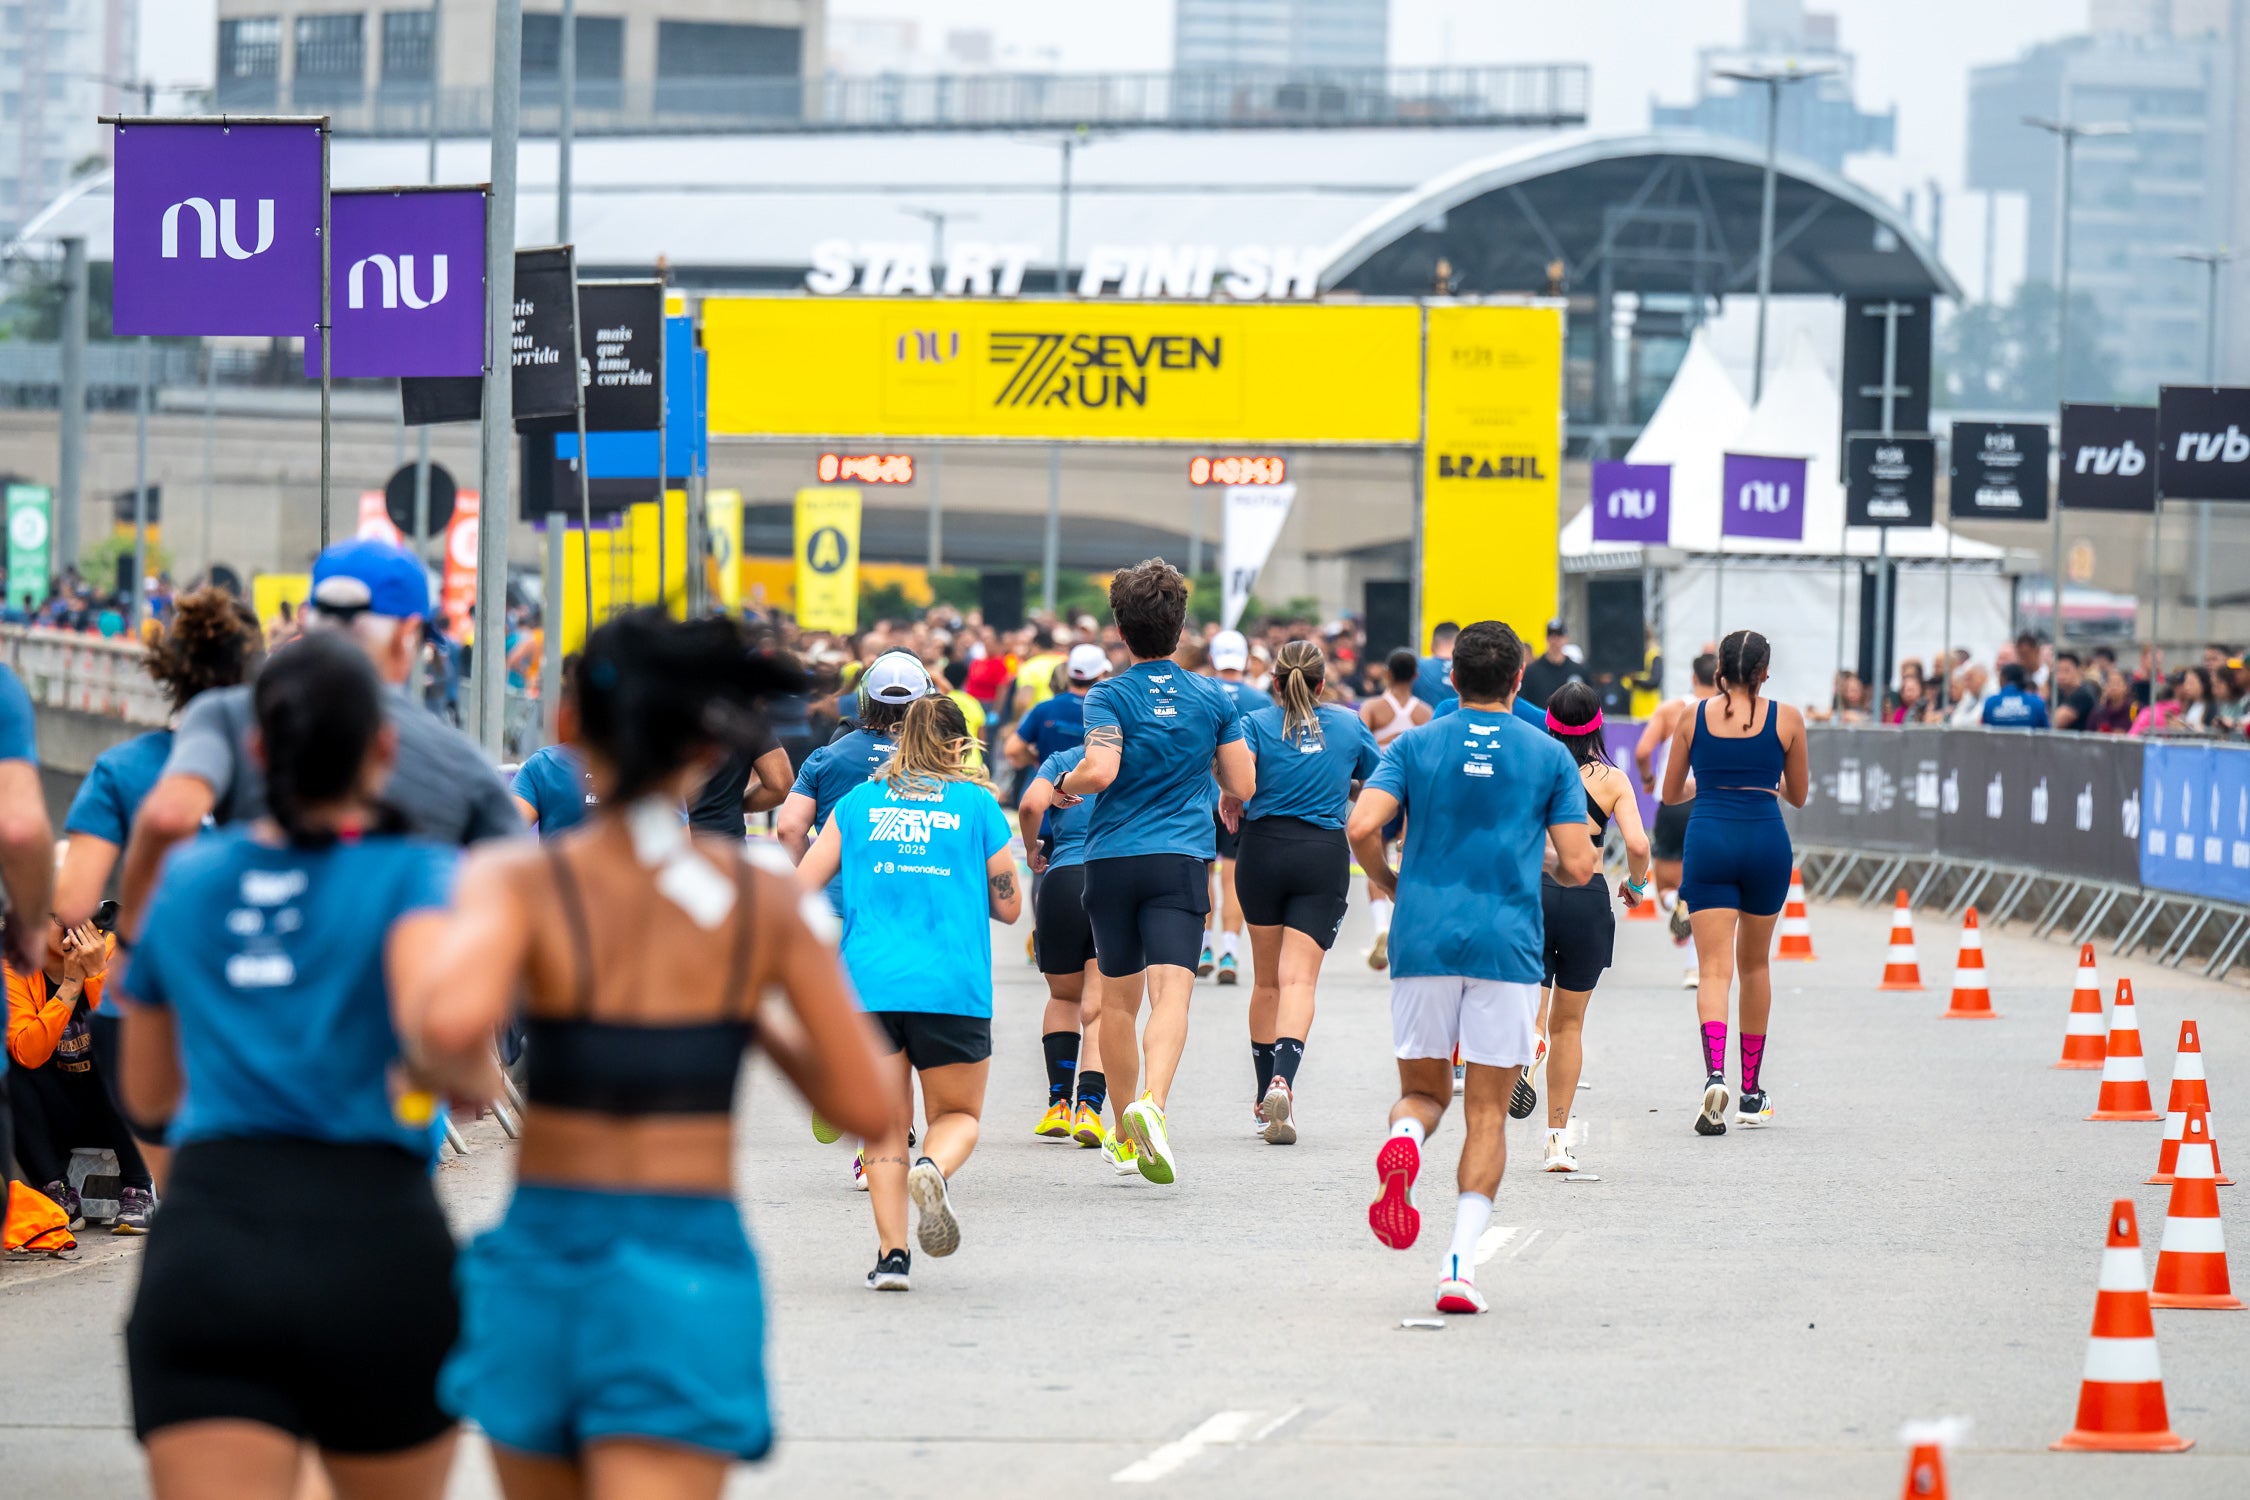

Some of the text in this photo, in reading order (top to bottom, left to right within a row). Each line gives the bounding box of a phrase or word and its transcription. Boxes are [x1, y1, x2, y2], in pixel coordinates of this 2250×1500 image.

[805, 240, 1325, 300] START FINISH
[512, 298, 535, 317] ais
[512, 335, 534, 350] ma
[596, 325, 633, 342] mais
[511, 346, 560, 367] orrida
[596, 343, 625, 359] que
[1069, 332, 1222, 370] SEVEN
[597, 357, 631, 372] uma
[596, 368, 653, 387] corrida
[1042, 372, 1148, 408] RUN
[2174, 424, 2250, 463] rvb
[1438, 454, 1547, 480] BRASIL
[2075, 440, 2147, 477] rvb
[898, 808, 961, 831] SEVEN
[886, 824, 931, 844] RUN
[898, 844, 927, 855] 2025
[897, 864, 951, 876] newonoficial
